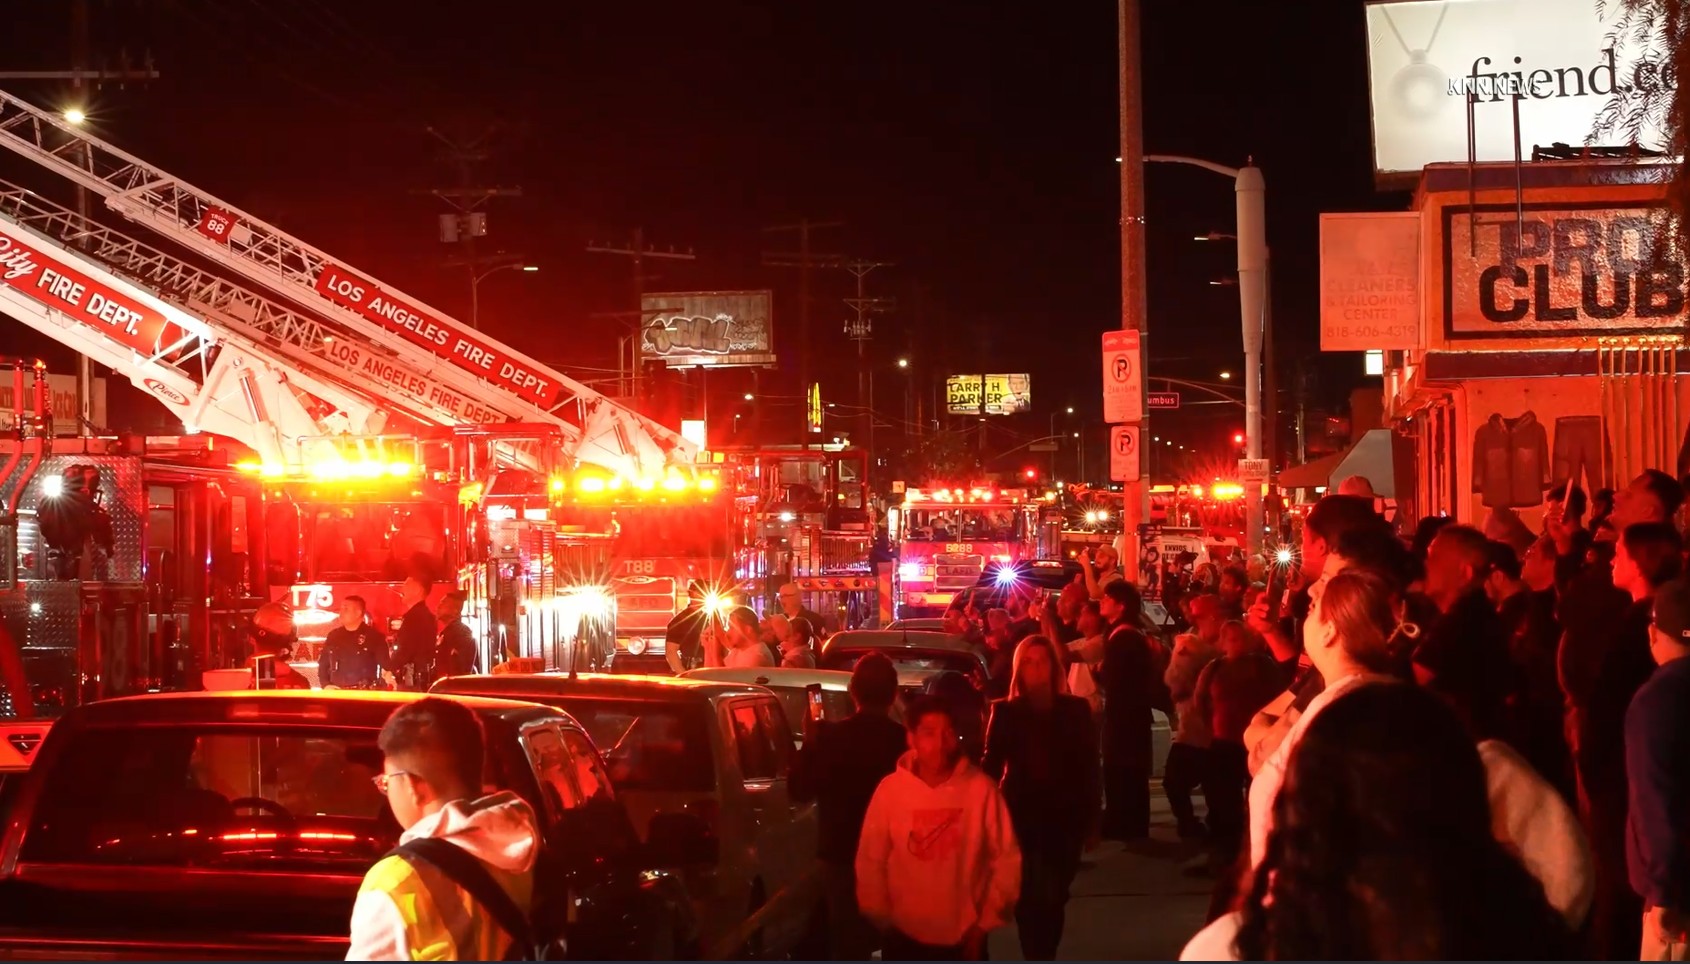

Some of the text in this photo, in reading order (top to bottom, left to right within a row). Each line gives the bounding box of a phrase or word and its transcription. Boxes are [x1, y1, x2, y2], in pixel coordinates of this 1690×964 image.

[210, 213, 230, 226] TRUCK
[207, 219, 225, 235] 88
[1327, 278, 1416, 292] CLEANERS
[1479, 261, 1685, 323] CLUB
[37, 268, 86, 306] FIRE
[85, 292, 143, 336] DEPT.
[1340, 294, 1416, 306] TAILORING
[1343, 308, 1398, 320] CENTER
[327, 274, 549, 398] LOS ANGELES FIRE DEPT.
[330, 341, 360, 367] LOS
[362, 356, 427, 397] ANGELES
[430, 389, 461, 413] FIRE
[950, 381, 1000, 393] LARR H
[1147, 396, 1175, 405] umbus
[624, 560, 654, 574] T88
[290, 585, 333, 608] T75
